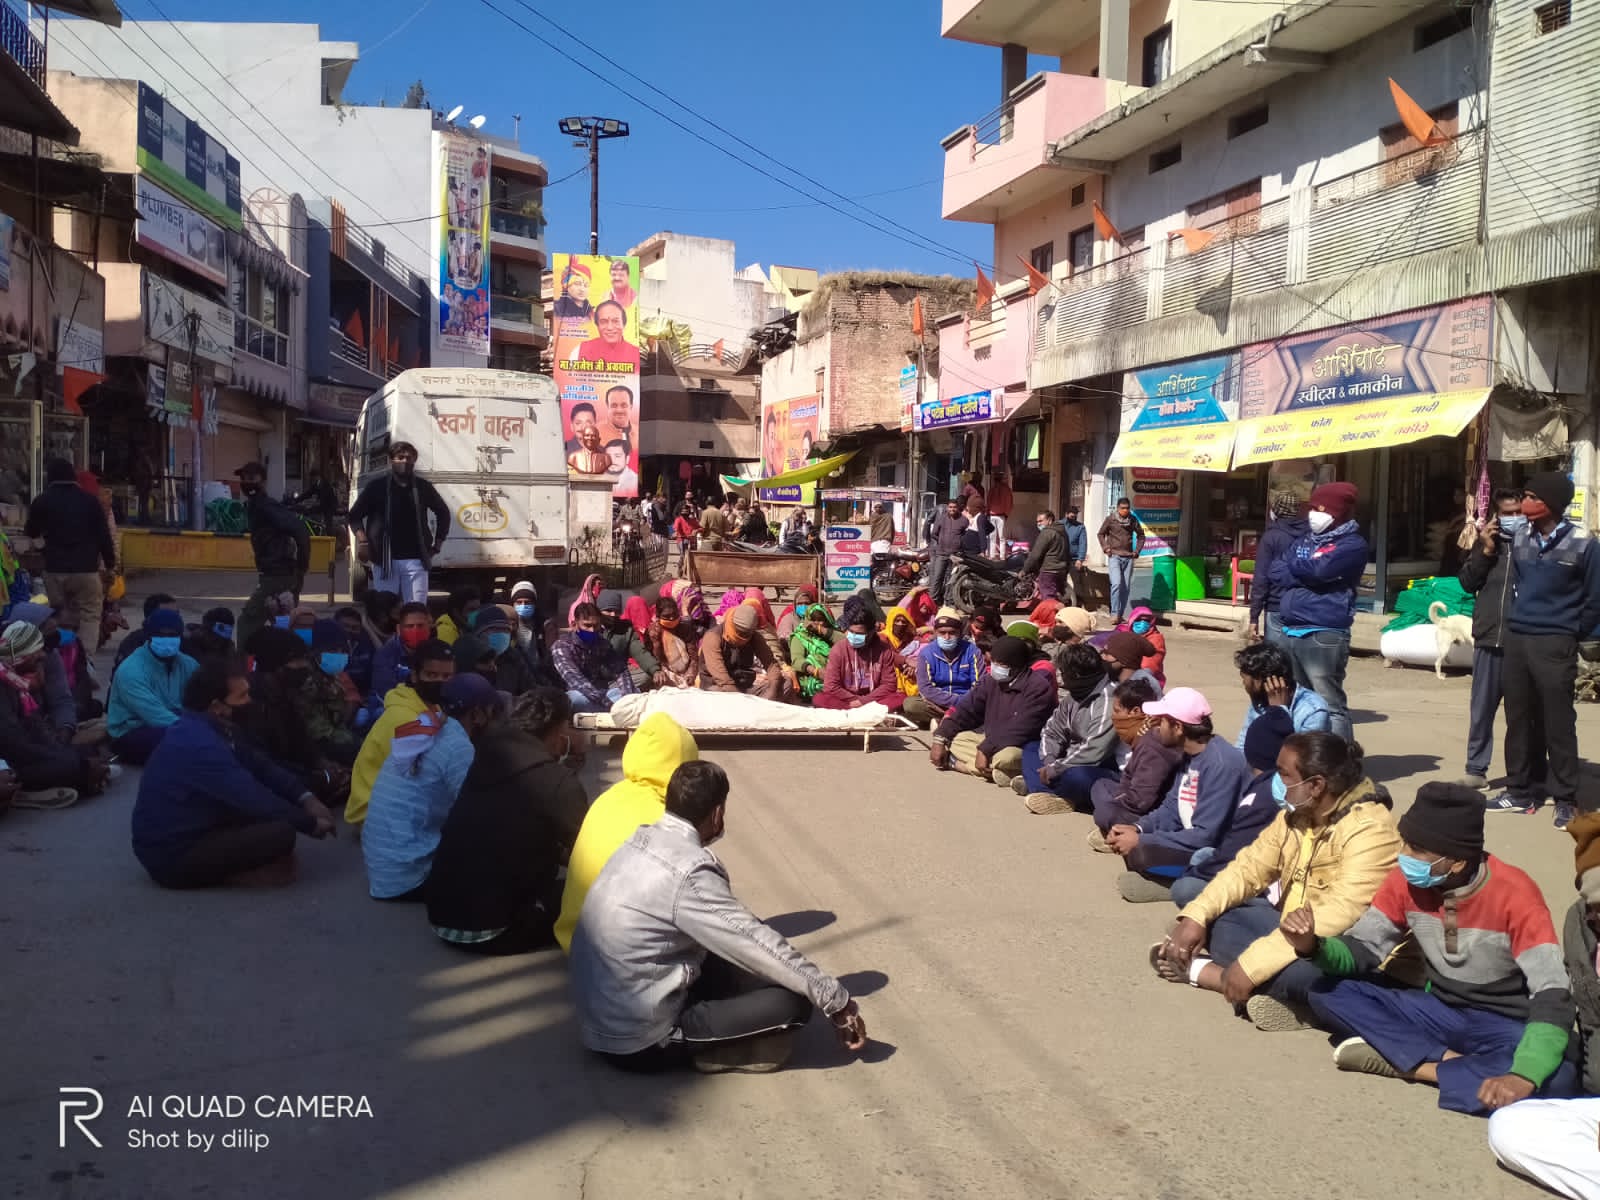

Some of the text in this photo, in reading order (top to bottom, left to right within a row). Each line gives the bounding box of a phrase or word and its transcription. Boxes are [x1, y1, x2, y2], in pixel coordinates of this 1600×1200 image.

[141, 189, 184, 230] PLUMBER
[1348, 374, 1405, 396] नमकीन
[437, 405, 525, 441] स्वर्ग वाहन
[463, 510, 498, 523] 2015
